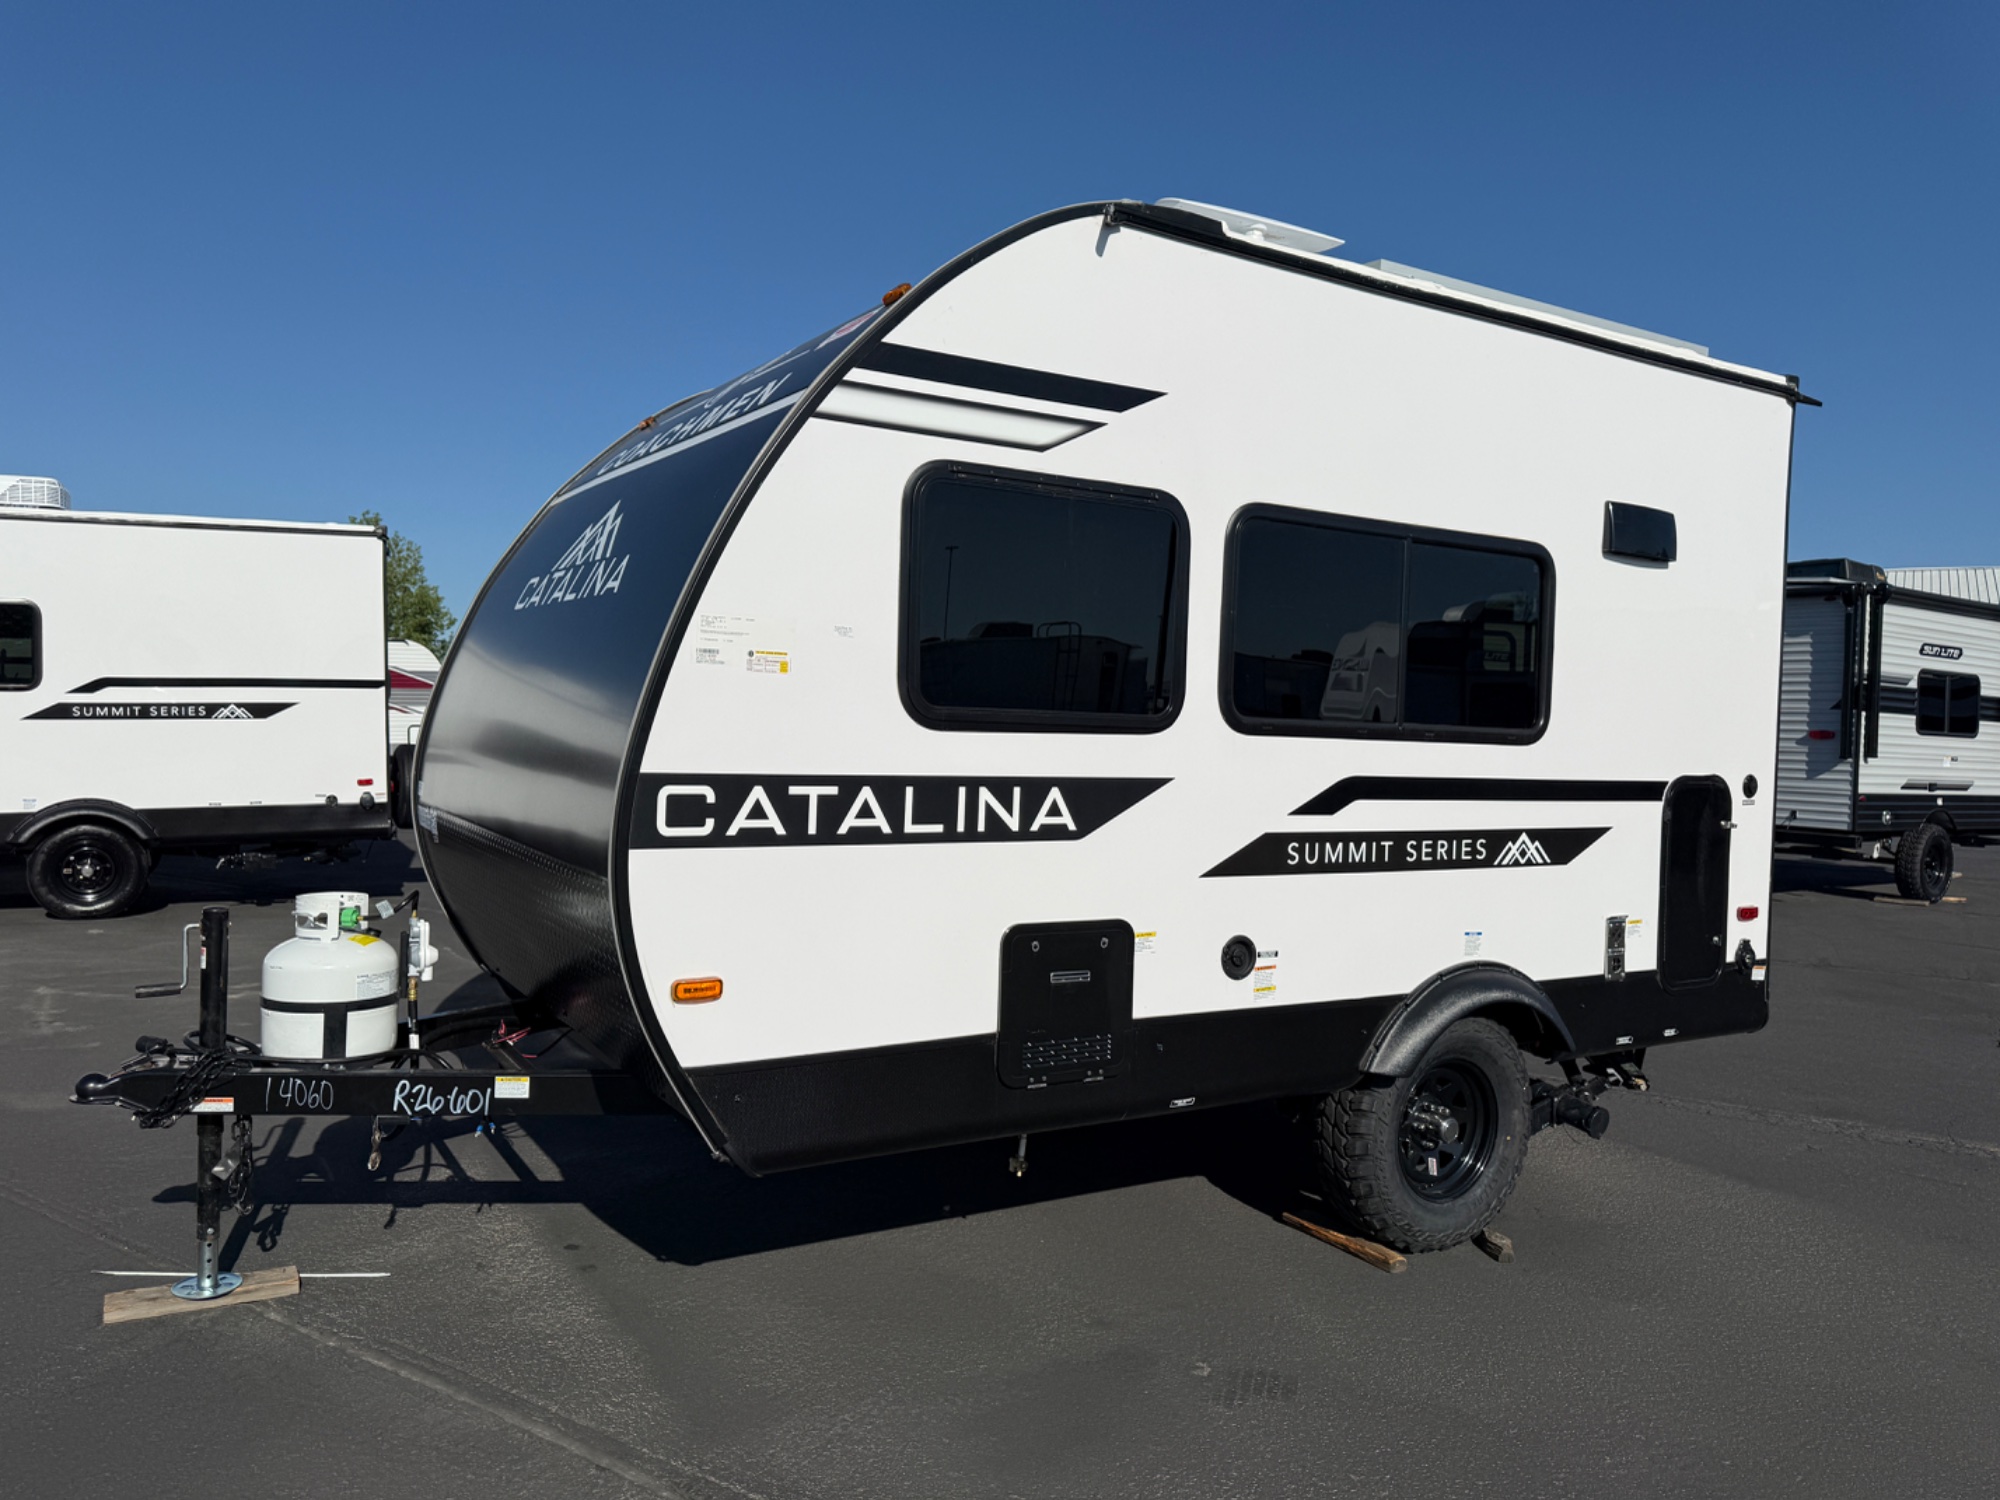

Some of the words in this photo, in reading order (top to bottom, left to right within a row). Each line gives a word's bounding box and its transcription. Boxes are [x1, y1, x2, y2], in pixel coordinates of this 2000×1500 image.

[598, 372, 792, 475] COACHMEN
[514, 553, 630, 610] CATALINA
[1941, 647, 1960, 658] LITE
[72, 705, 142, 717] SUMMIT
[150, 705, 207, 717] SERIES
[656, 785, 1077, 837] CATALINA
[1286, 841, 1395, 865] SUMMIT
[1405, 838, 1488, 862] SERIES
